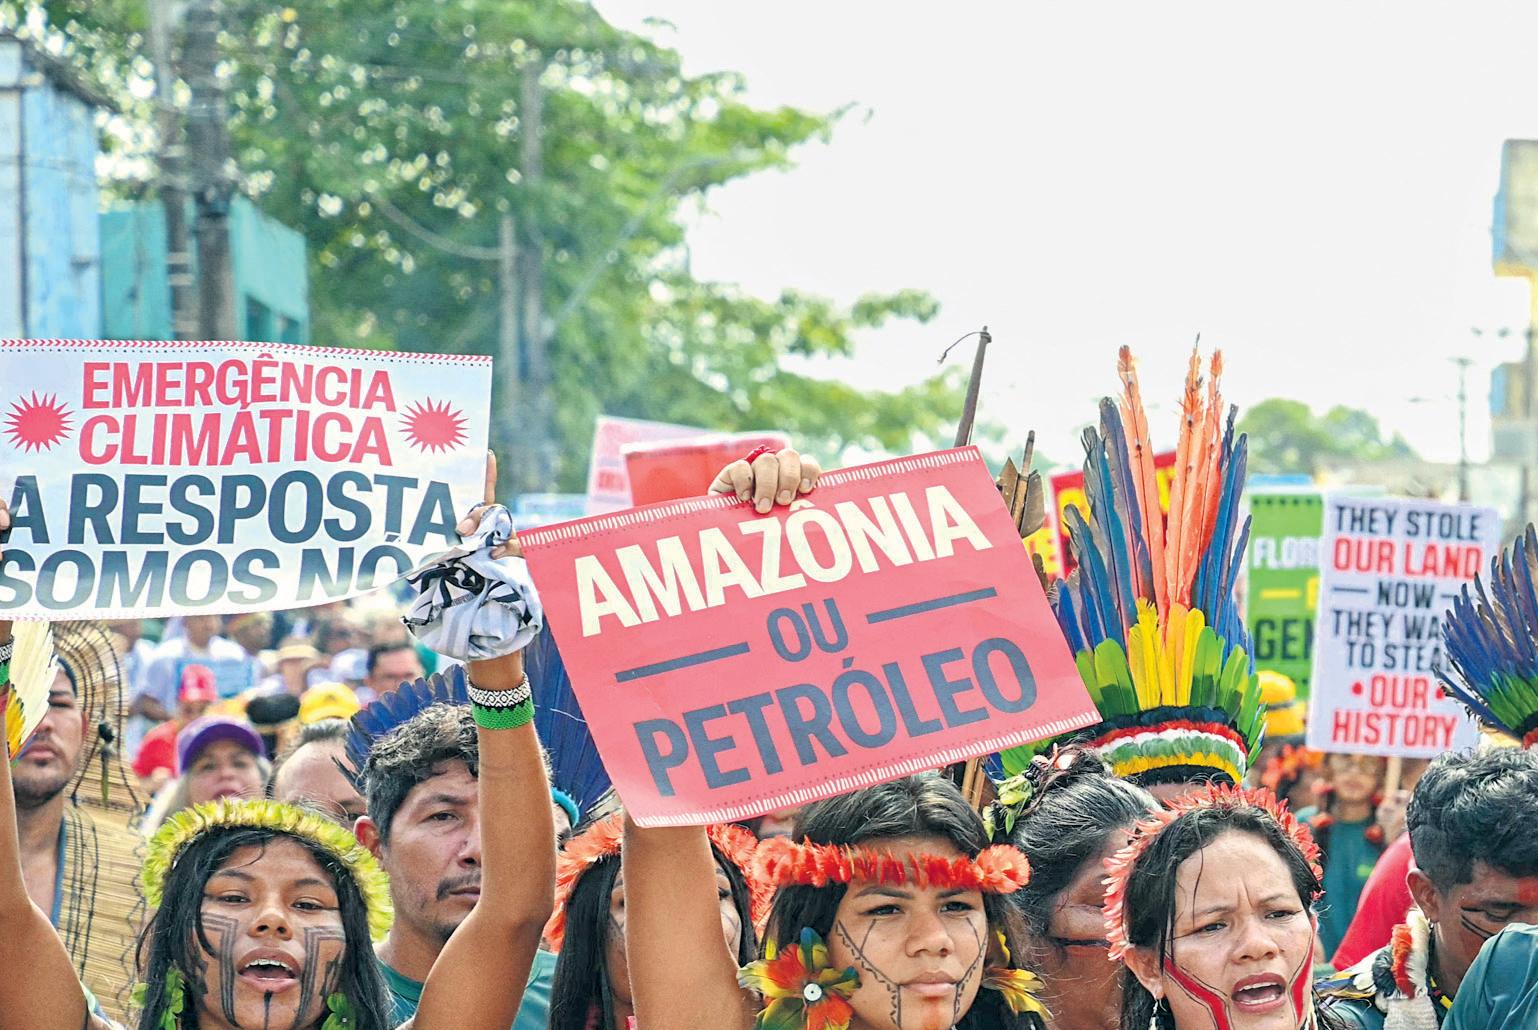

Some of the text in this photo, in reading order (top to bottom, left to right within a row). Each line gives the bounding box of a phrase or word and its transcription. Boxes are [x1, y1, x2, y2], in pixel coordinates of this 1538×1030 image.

[82, 353, 396, 412] EMERGÊNCIA
[79, 402, 392, 467] CLIMÁTICA
[0, 470, 463, 546] A RESPOSTA
[1335, 505, 1480, 541] THEY STOLE
[0, 534, 448, 610] SOMOS NÓ
[574, 484, 994, 637] AMAZÔNIA
[1333, 537, 1483, 579] OUR LAND
[1377, 581, 1435, 609] NOW
[766, 597, 849, 663] OU
[1332, 609, 1441, 640] THEY WA
[1347, 641, 1375, 668] TO
[1370, 674, 1429, 709] OUR
[632, 637, 1039, 798] PETRÓLEO
[1331, 711, 1458, 748] HISTORY
